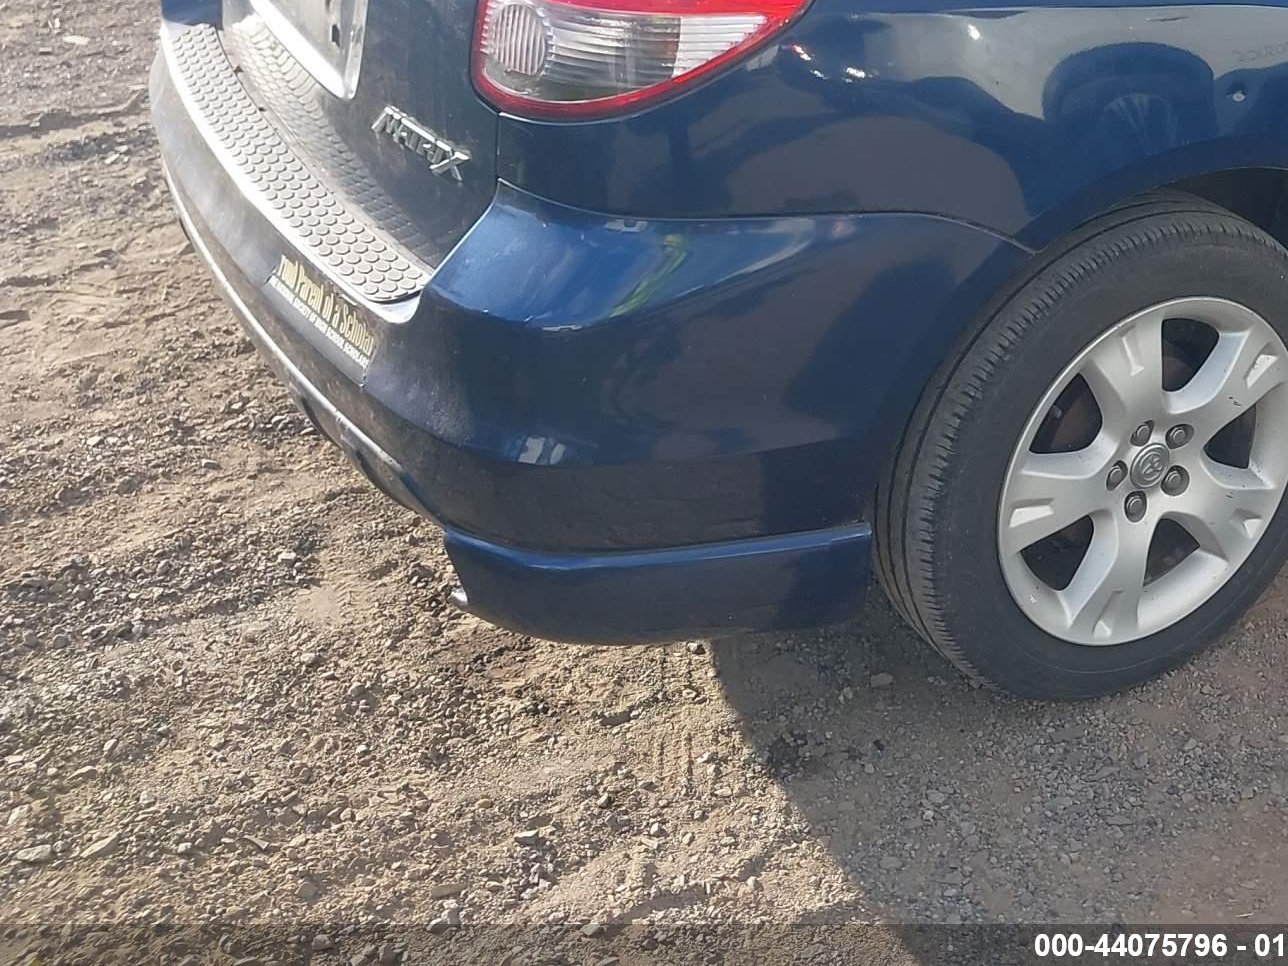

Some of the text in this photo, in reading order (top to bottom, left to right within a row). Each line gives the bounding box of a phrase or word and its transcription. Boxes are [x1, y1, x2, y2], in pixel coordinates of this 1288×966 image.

[371, 105, 472, 182] MATRIX
[294, 263, 324, 314] Parent
[322, 292, 334, 323] of
[331, 303, 342, 329] a
[339, 303, 374, 357] Scholar
